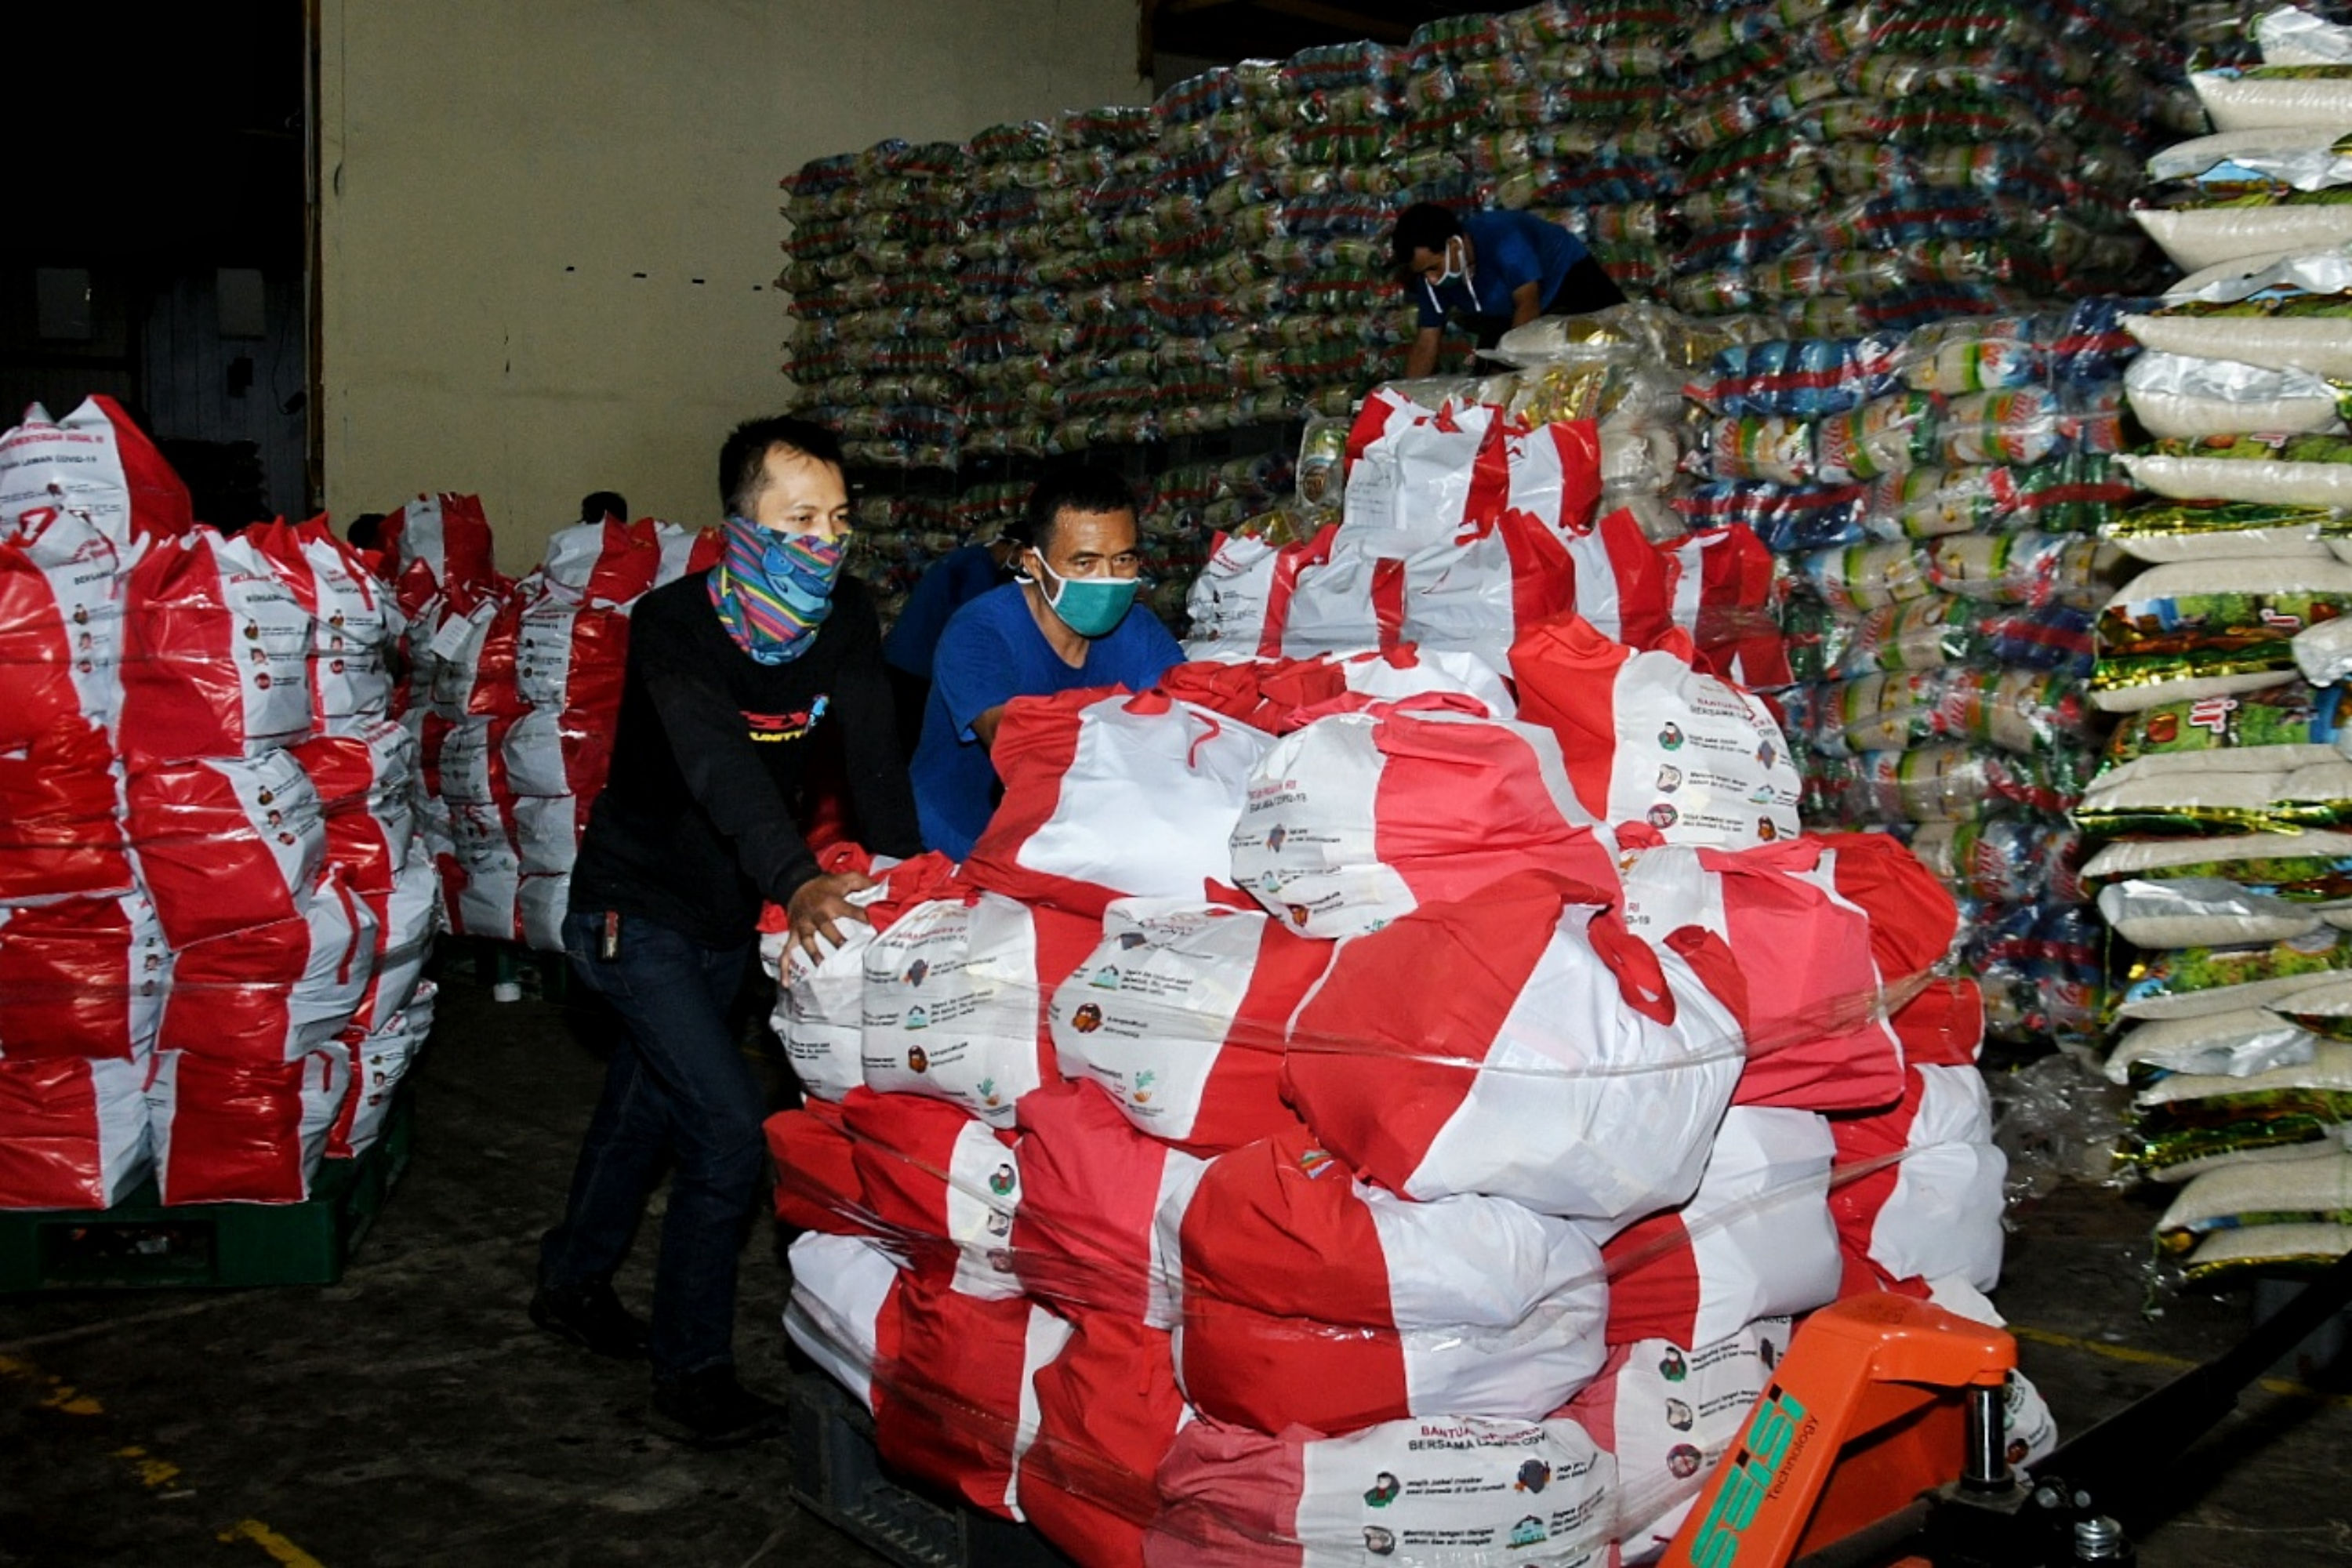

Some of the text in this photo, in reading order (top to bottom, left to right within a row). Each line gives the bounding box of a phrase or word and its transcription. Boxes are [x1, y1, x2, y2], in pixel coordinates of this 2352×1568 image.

[1628, 902, 1640, 913] RI
[1421, 1424, 1475, 1439] BANTUA
[1408, 1439, 1475, 1451] BERSAMA
[1765, 1415, 1819, 1502] Technology
